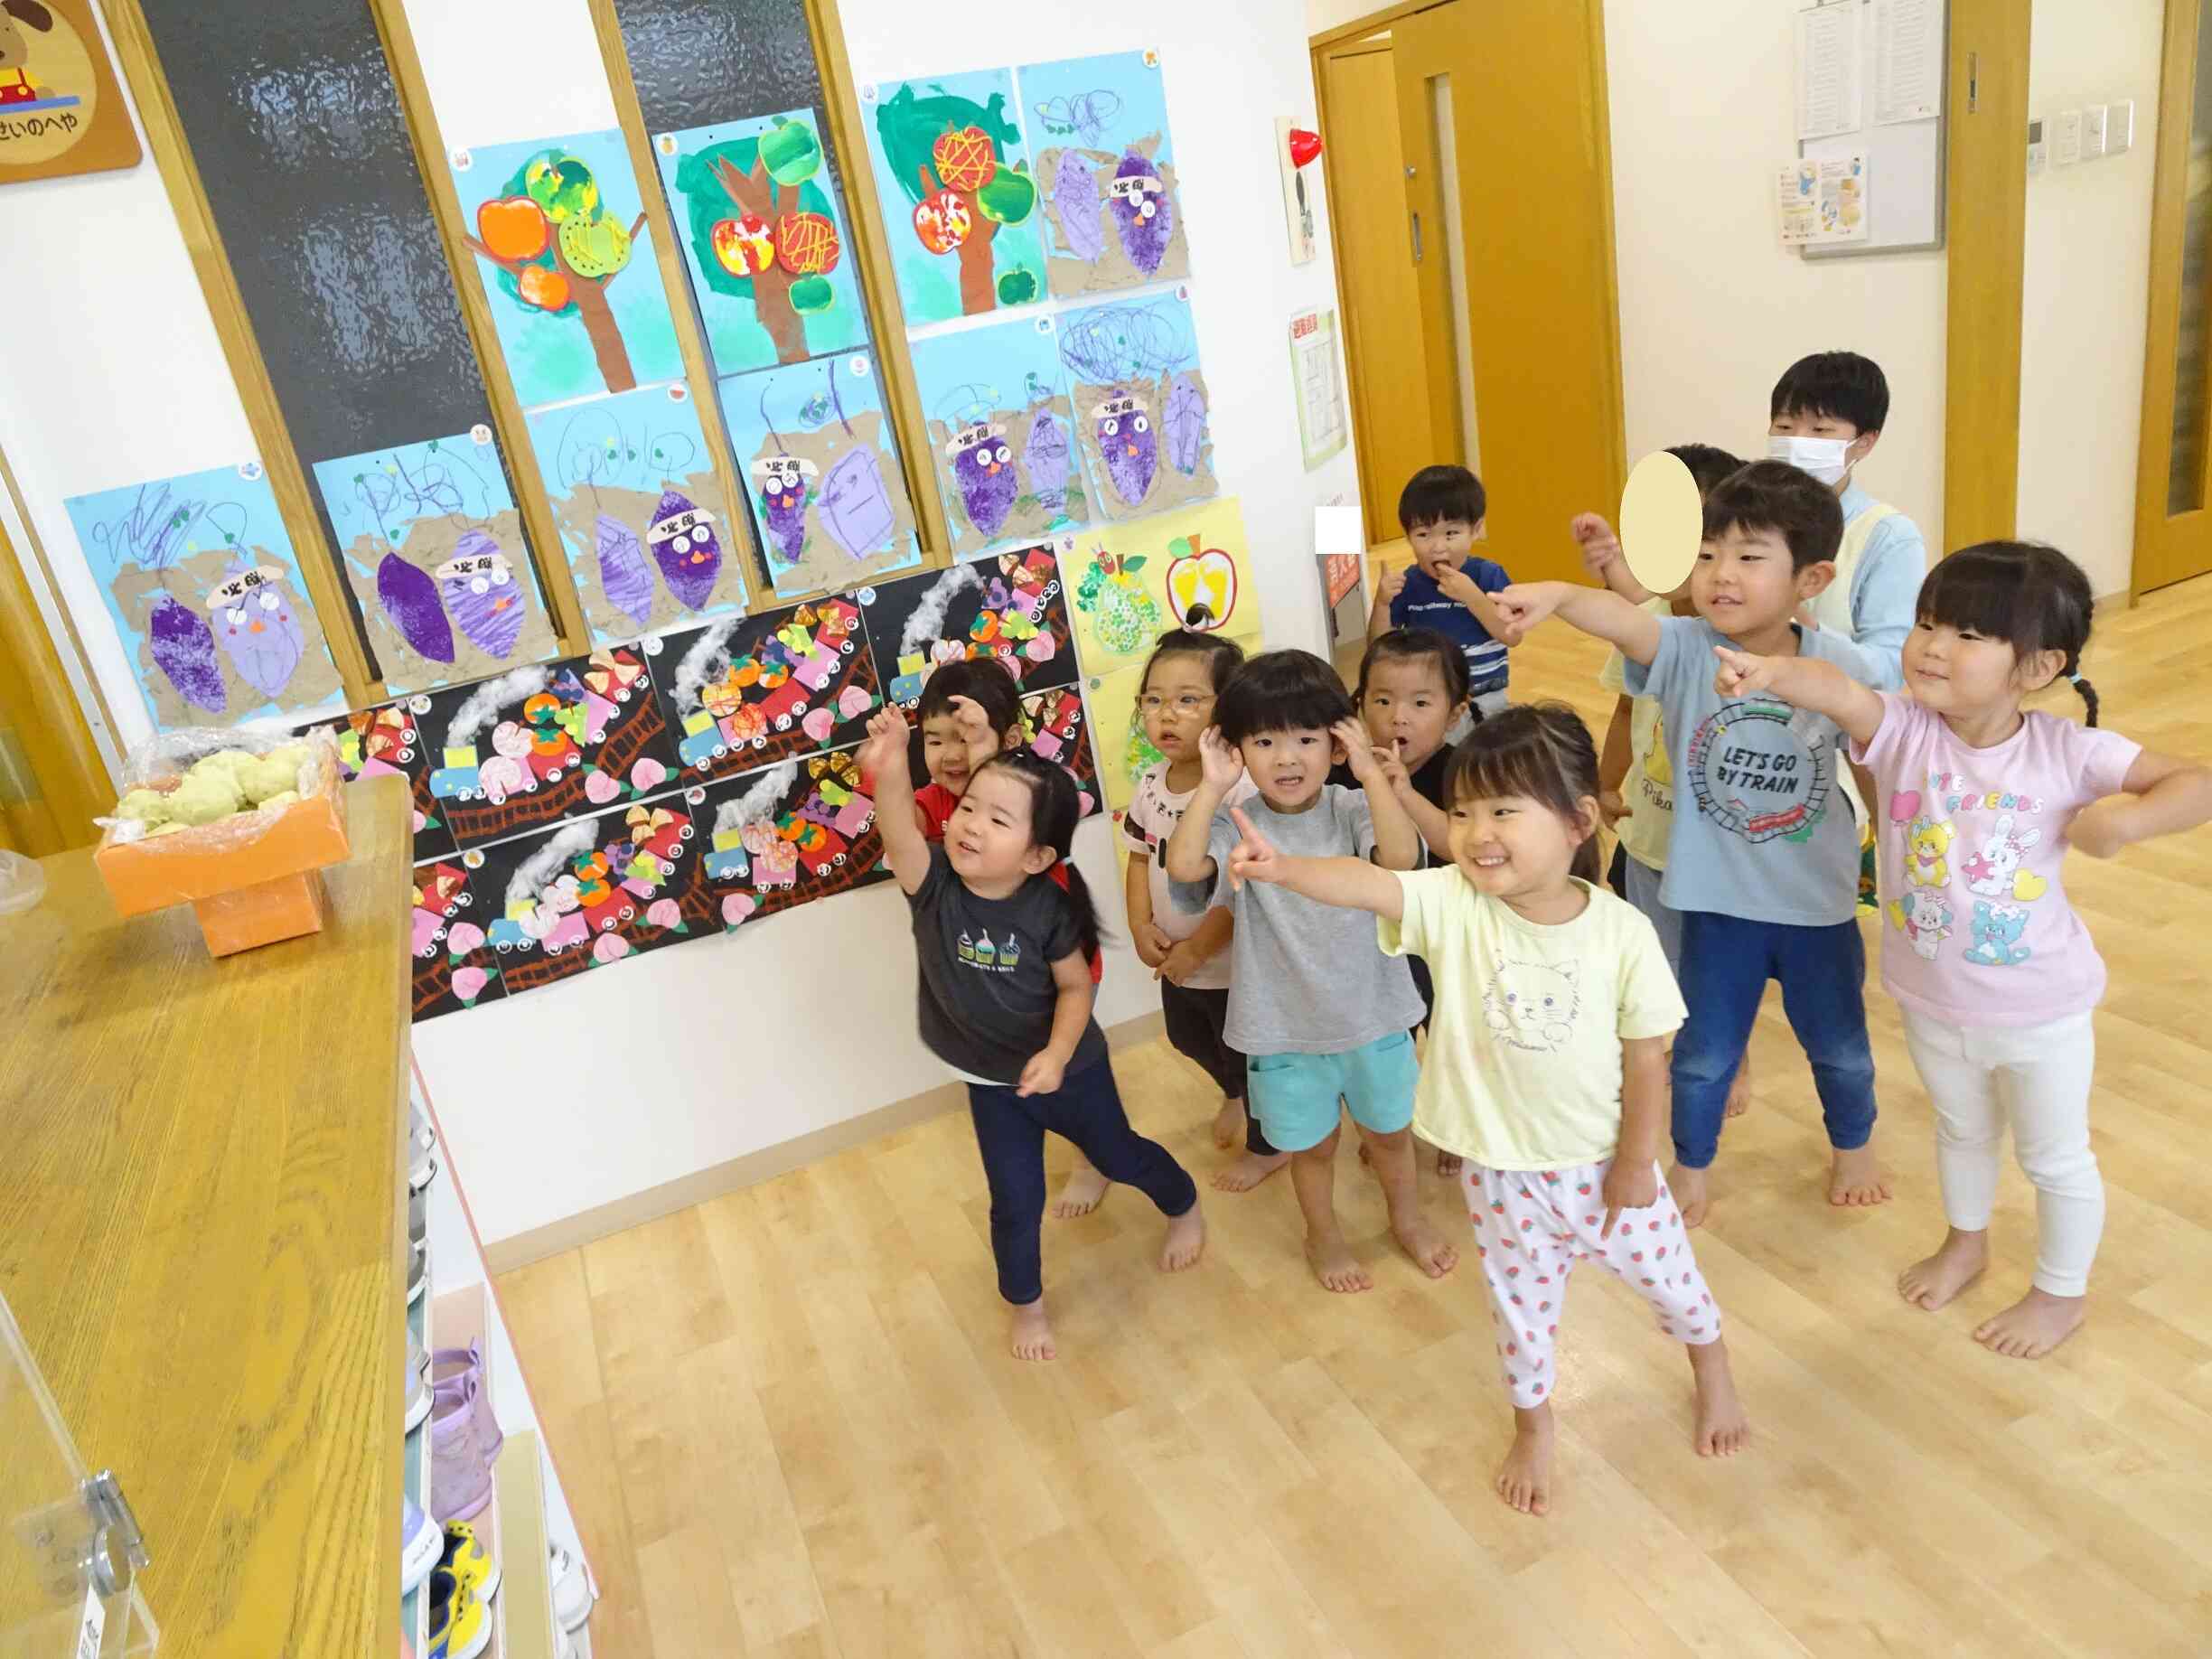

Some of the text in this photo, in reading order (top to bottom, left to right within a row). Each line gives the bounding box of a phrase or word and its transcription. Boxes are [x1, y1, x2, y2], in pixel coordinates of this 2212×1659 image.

[1723, 745, 1797, 772] LET'S GO
[1718, 765, 1799, 794] BY TRAIN
[1945, 792, 2044, 814] FRIENDS
